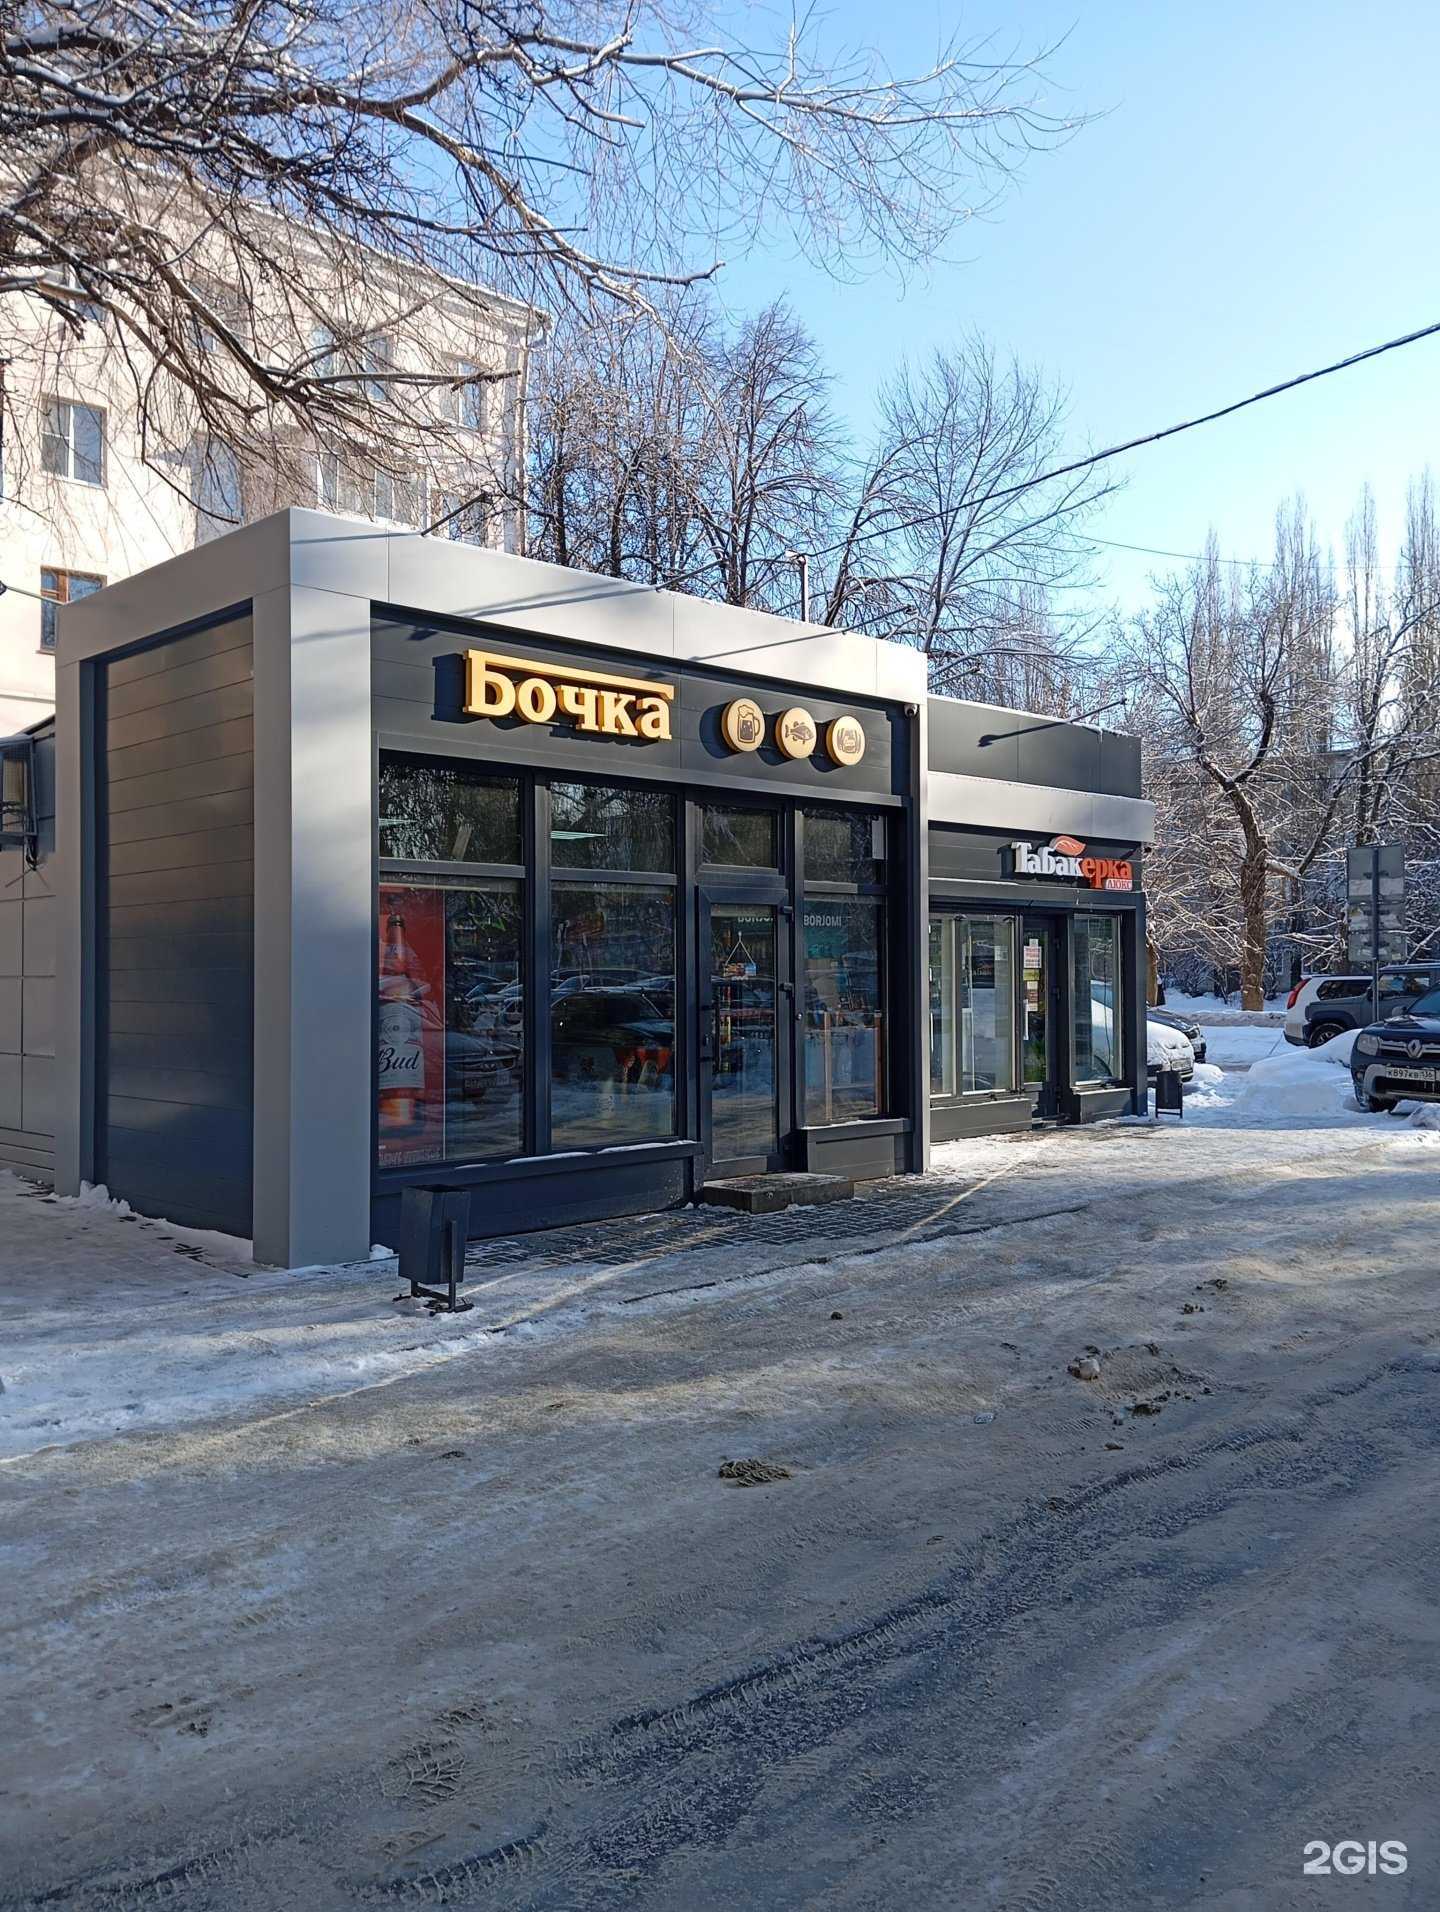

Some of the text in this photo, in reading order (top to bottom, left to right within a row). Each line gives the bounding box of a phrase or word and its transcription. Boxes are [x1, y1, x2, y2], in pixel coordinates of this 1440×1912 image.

[465, 649, 675, 740] Бочка
[1011, 841, 1133, 889] Табакерка
[1106, 879, 1132, 890] ЛЮКС
[803, 914, 842, 928] BORJOMI
[378, 1047, 420, 1073] Bud
